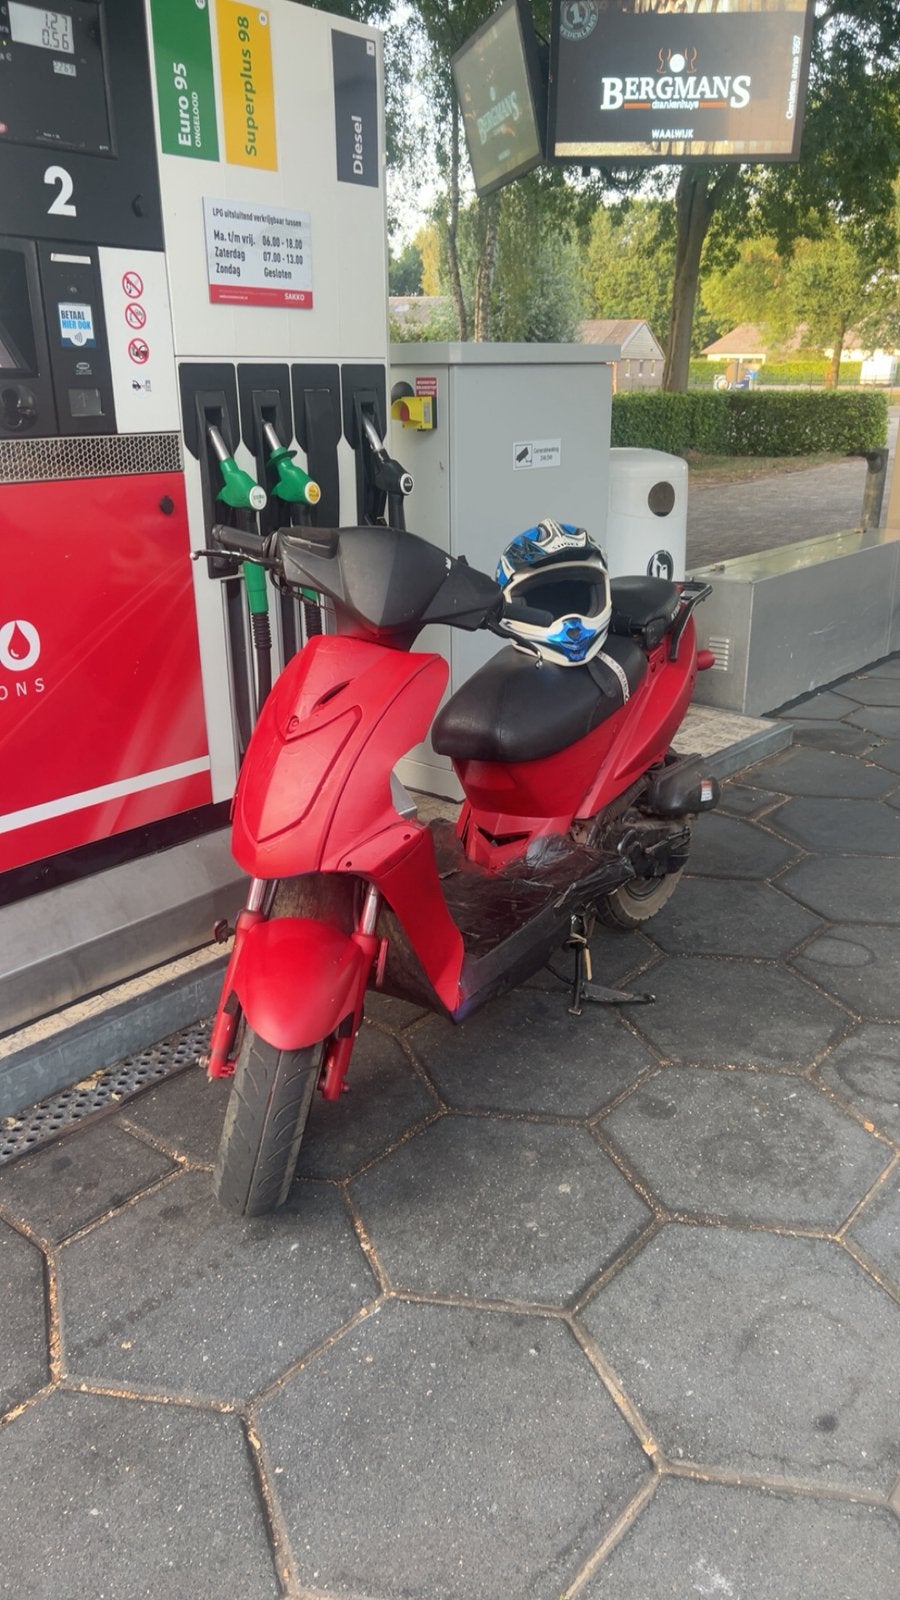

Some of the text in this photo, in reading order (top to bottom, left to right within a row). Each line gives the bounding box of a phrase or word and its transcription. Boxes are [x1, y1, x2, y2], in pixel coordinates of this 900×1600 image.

[42, 29, 69, 50] 0.56
[237, 16, 259, 156] Superplus 98
[600, 75, 751, 110] BERGMANS
[173, 62, 192, 147] Euro 95
[191, 91, 202, 148] ONGELOOD
[651, 128, 694, 139] WAALWIJK
[351, 115, 364, 175] Diesel
[44, 165, 77, 217] 2
[212, 207, 302, 227] LPG uitsluitend verkrijgbaar tussen
[213, 229, 227, 242] Ma.
[228, 231, 241, 244] t/m
[241, 233, 256, 247] vrij.
[214, 246, 246, 262] Zaterdag
[215, 262, 292, 280] Zondag Gesloten
[284, 292, 305, 302] SAKKO
[60, 310, 86, 321] BETAAL
[62, 320, 92, 330] HIER OOK
